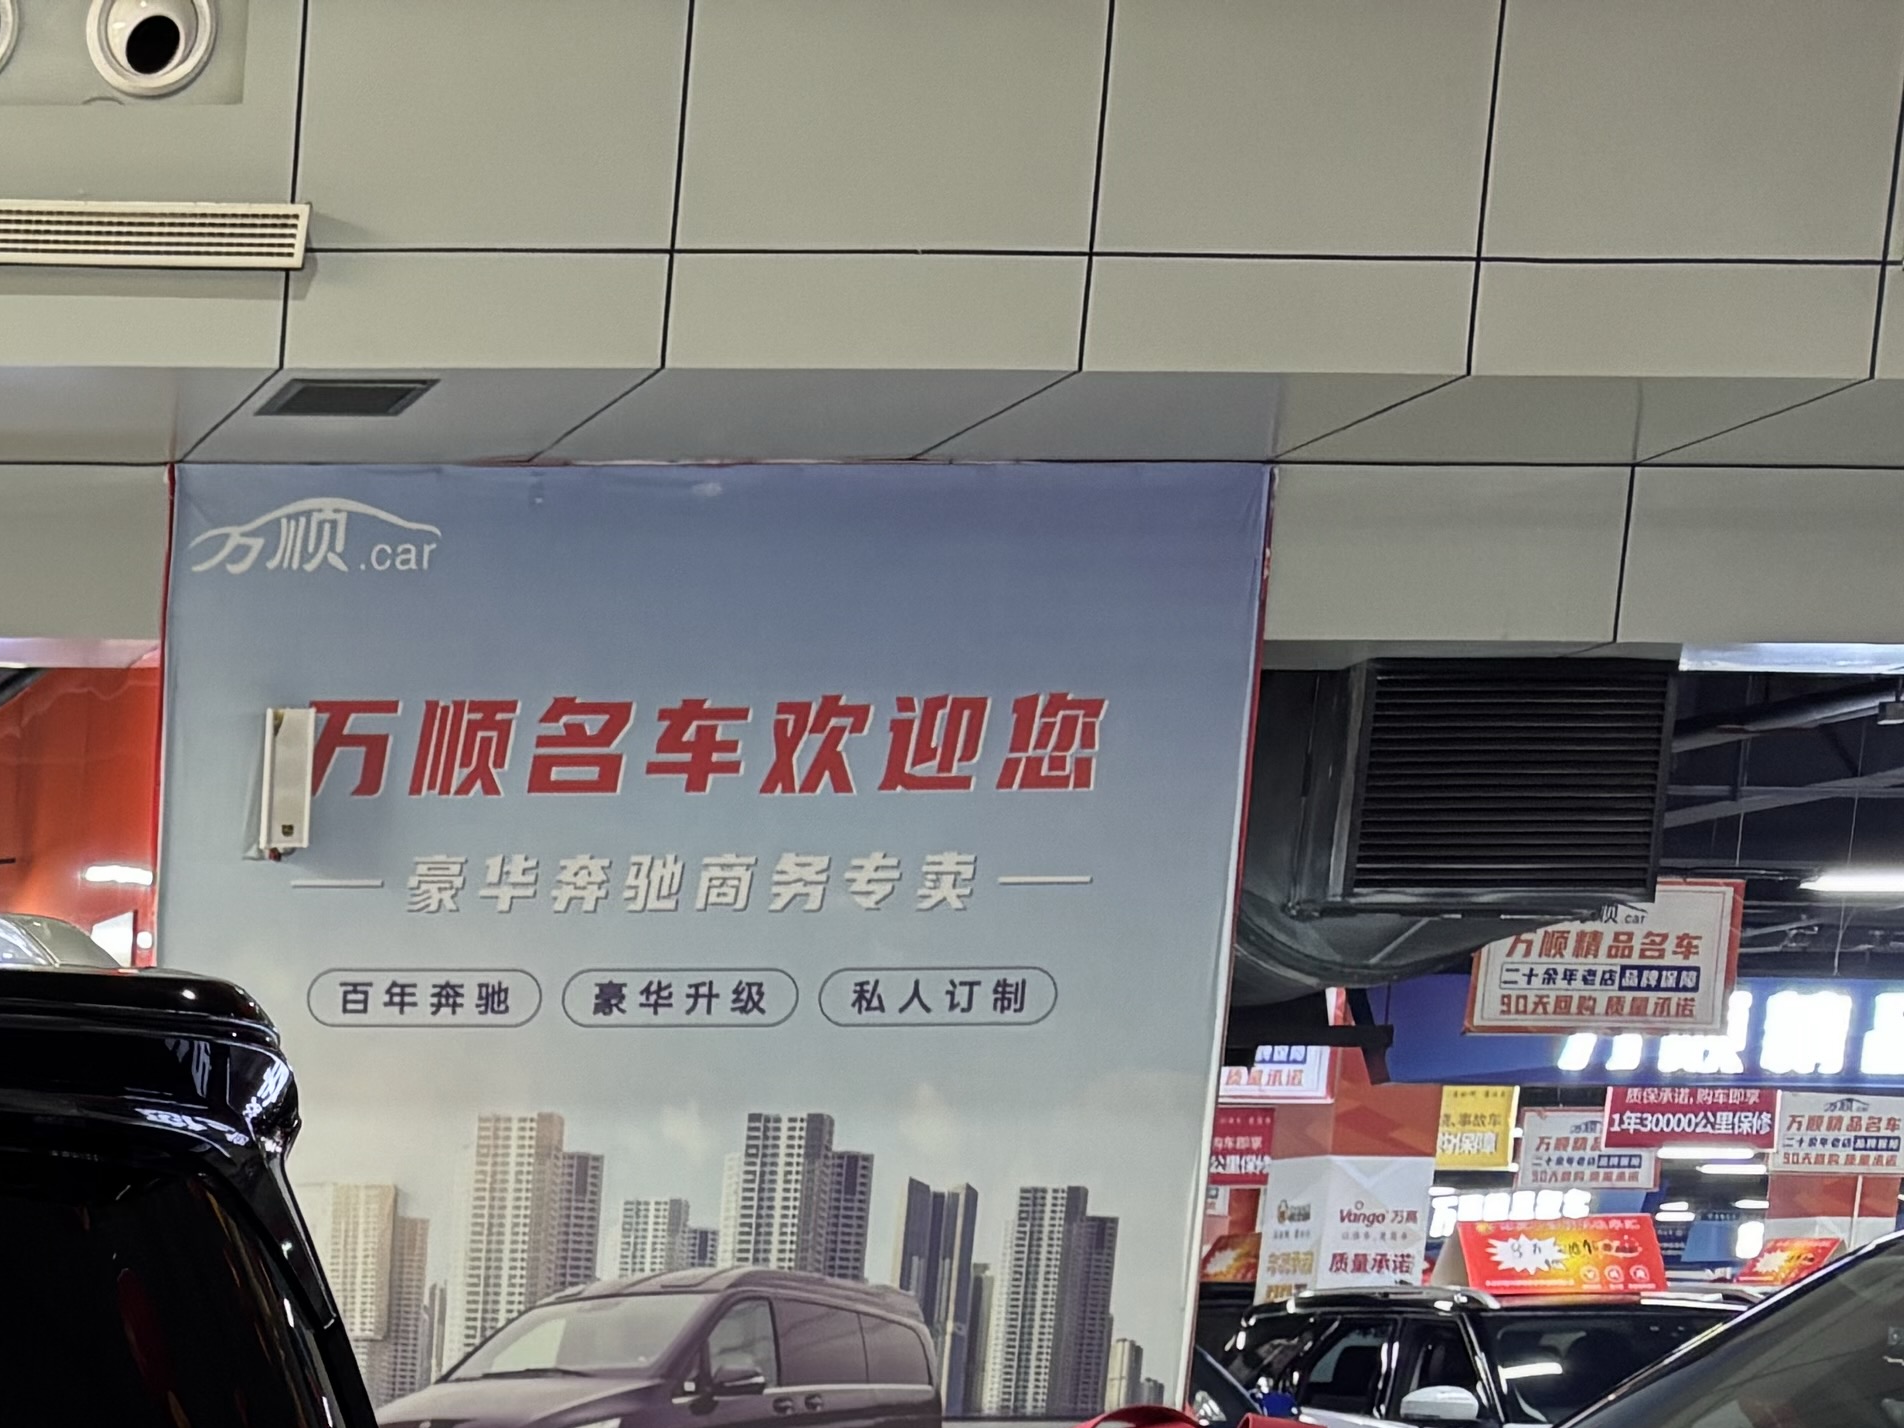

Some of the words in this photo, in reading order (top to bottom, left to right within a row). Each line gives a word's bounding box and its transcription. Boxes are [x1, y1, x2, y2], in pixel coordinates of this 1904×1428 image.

[304, 690, 1110, 798] 万顺名车欢迎您
[404, 851, 980, 915] 豪华奔驰商务专卖
[1504, 929, 1704, 961] 万顺精品名车
[339, 980, 513, 1017] 百年奔驰
[592, 978, 768, 1017] 豪华升级
[850, 978, 1031, 1016] 私人订制
[1608, 1110, 1773, 1136] 1年30000公里保修
